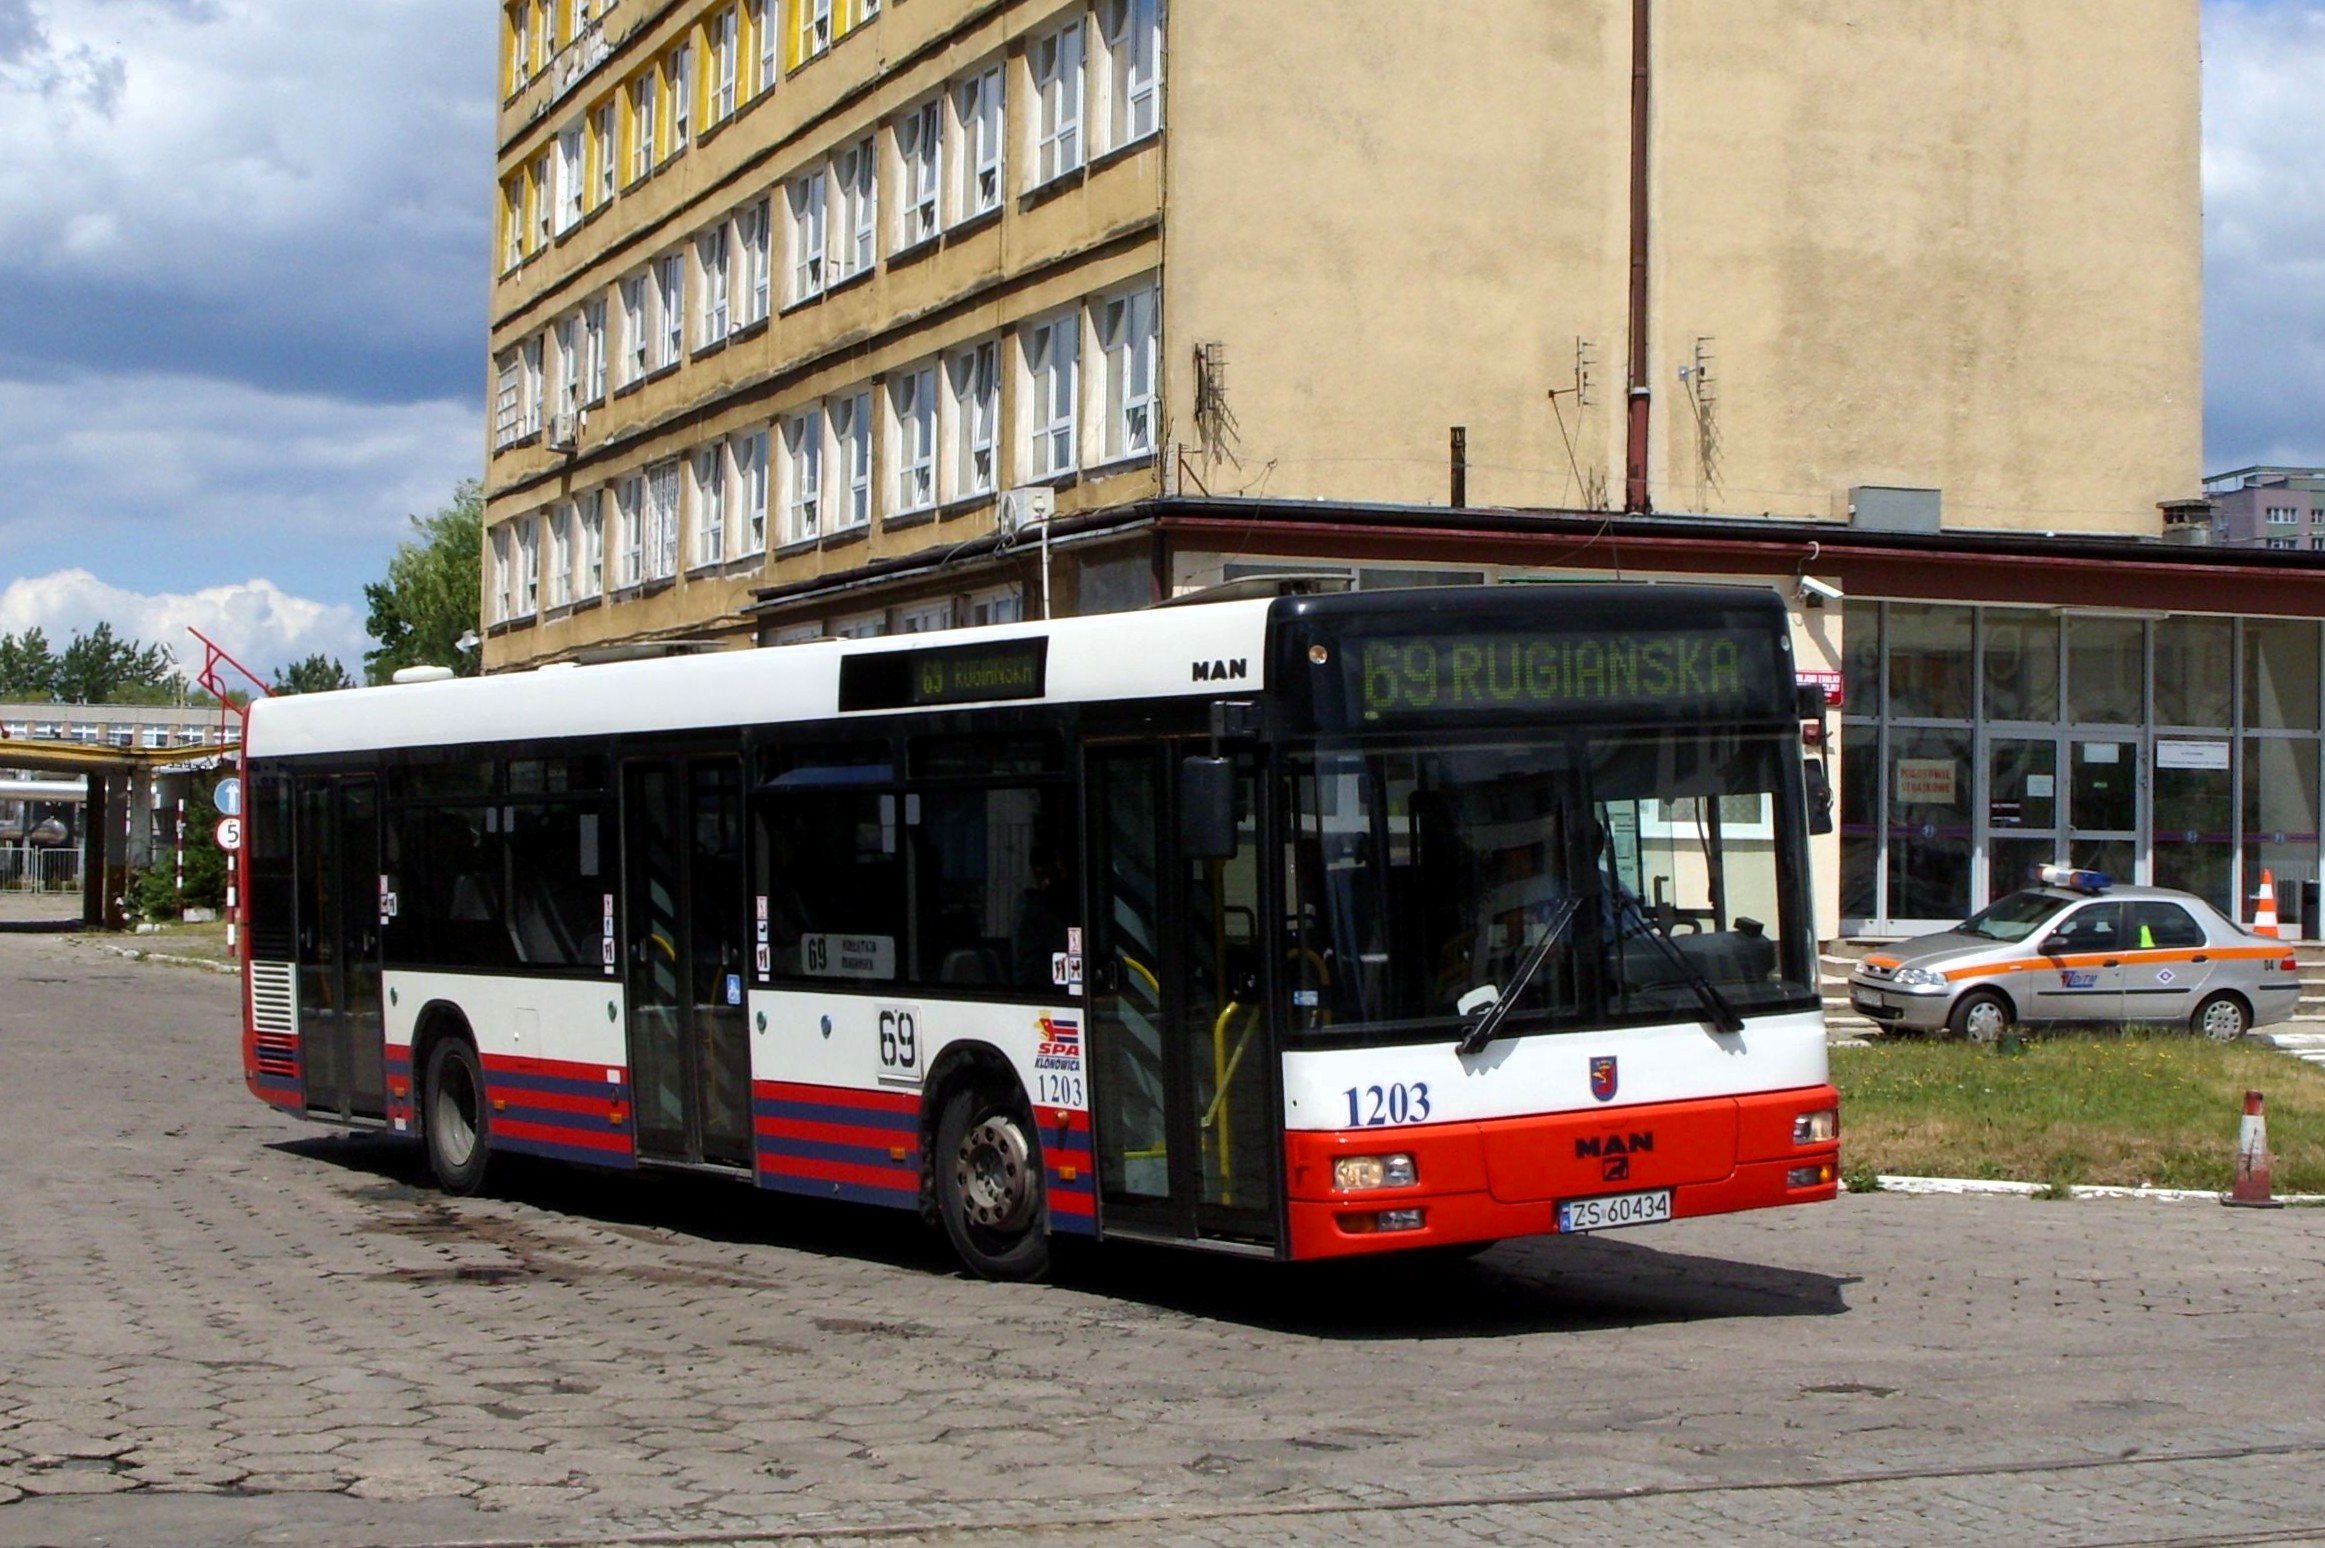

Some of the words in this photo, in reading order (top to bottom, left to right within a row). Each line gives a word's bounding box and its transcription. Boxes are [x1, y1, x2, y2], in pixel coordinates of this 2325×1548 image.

[1192, 658, 1247, 682] MAN
[1364, 641, 1436, 707] 69
[228, 824, 239, 843] 5
[808, 939, 827, 970] 69
[879, 1010, 915, 1068] 69
[1038, 1042, 1080, 1056] SPA
[1034, 1057, 1080, 1071] KLONOWICA
[1039, 1074, 1083, 1107] 1203
[1342, 1082, 1430, 1128] 1203
[1575, 1131, 1654, 1158] MAN
[1573, 1202, 1600, 1227] ZS
[1607, 1194, 1667, 1222] 60434
